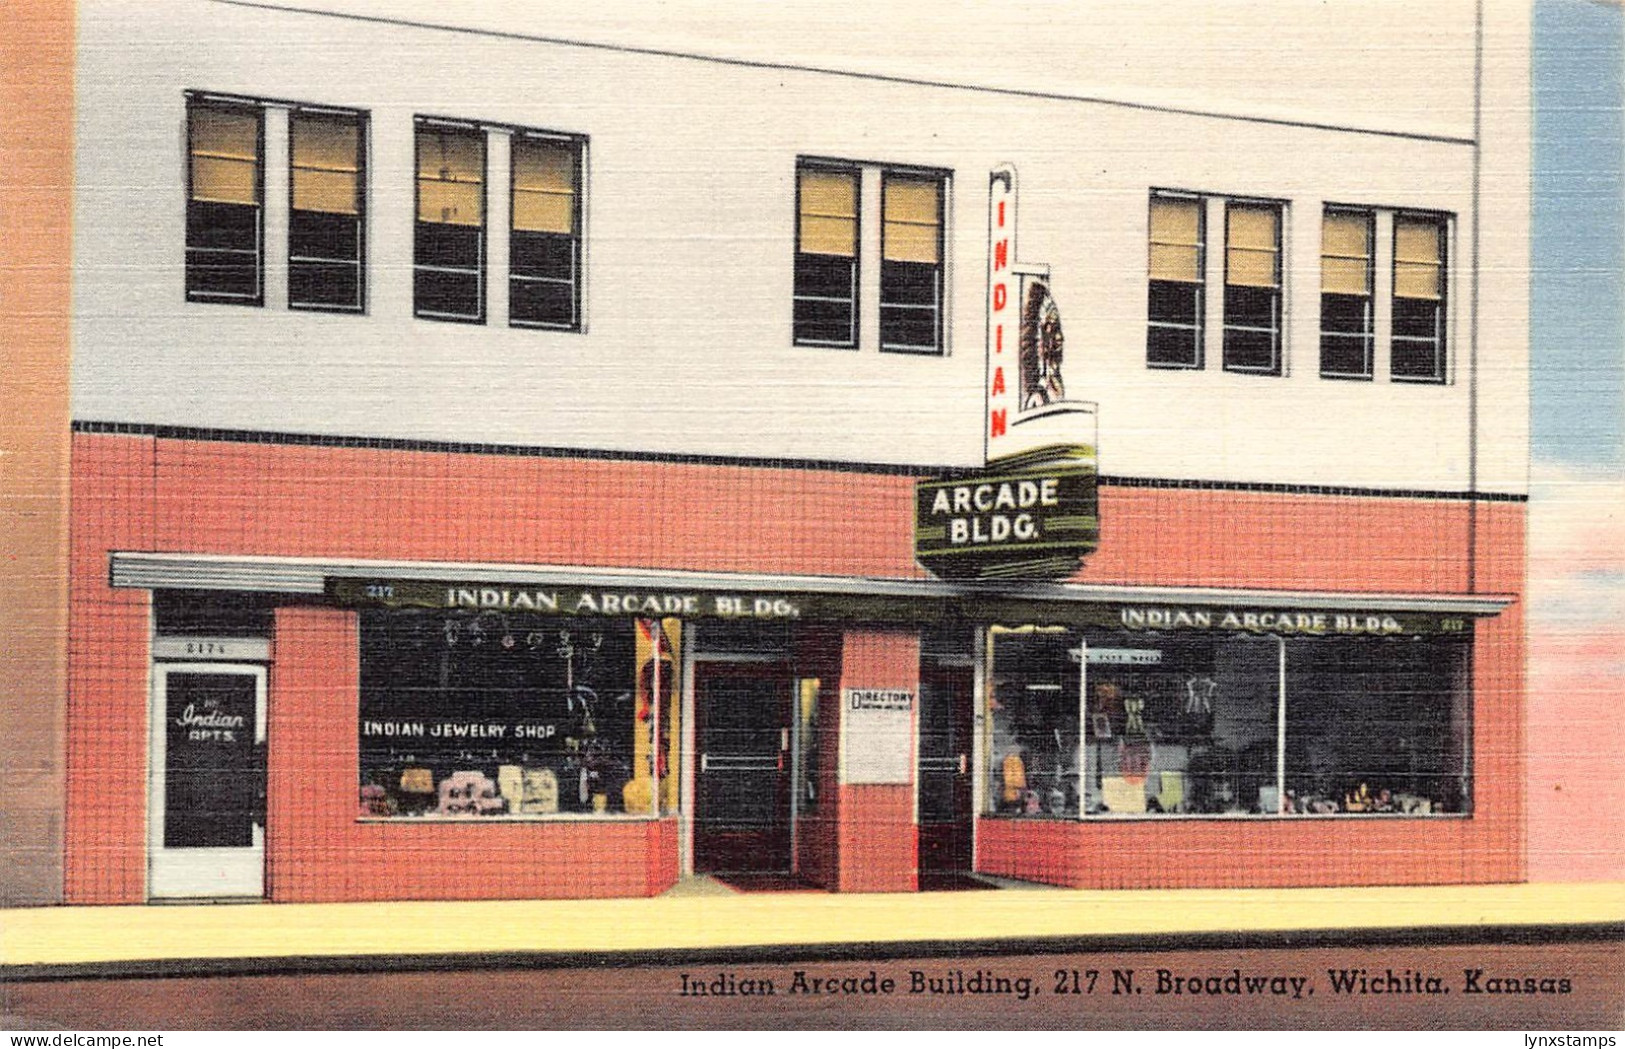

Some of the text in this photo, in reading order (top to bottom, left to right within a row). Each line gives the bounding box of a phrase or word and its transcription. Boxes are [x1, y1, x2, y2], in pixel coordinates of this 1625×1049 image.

[991, 201, 1008, 438] INDIAN
[931, 479, 1059, 514] ARCADE
[950, 515, 1039, 544] BLDG.
[448, 588, 800, 618] INDIAN ARCADE BLDG.
[1121, 608, 1403, 632] INDIAN ARCADE BLDG.
[852, 691, 915, 710] DIRECTORY
[176, 702, 244, 727] Indian
[363, 721, 556, 739] INDIAN JEWELRY SHOP
